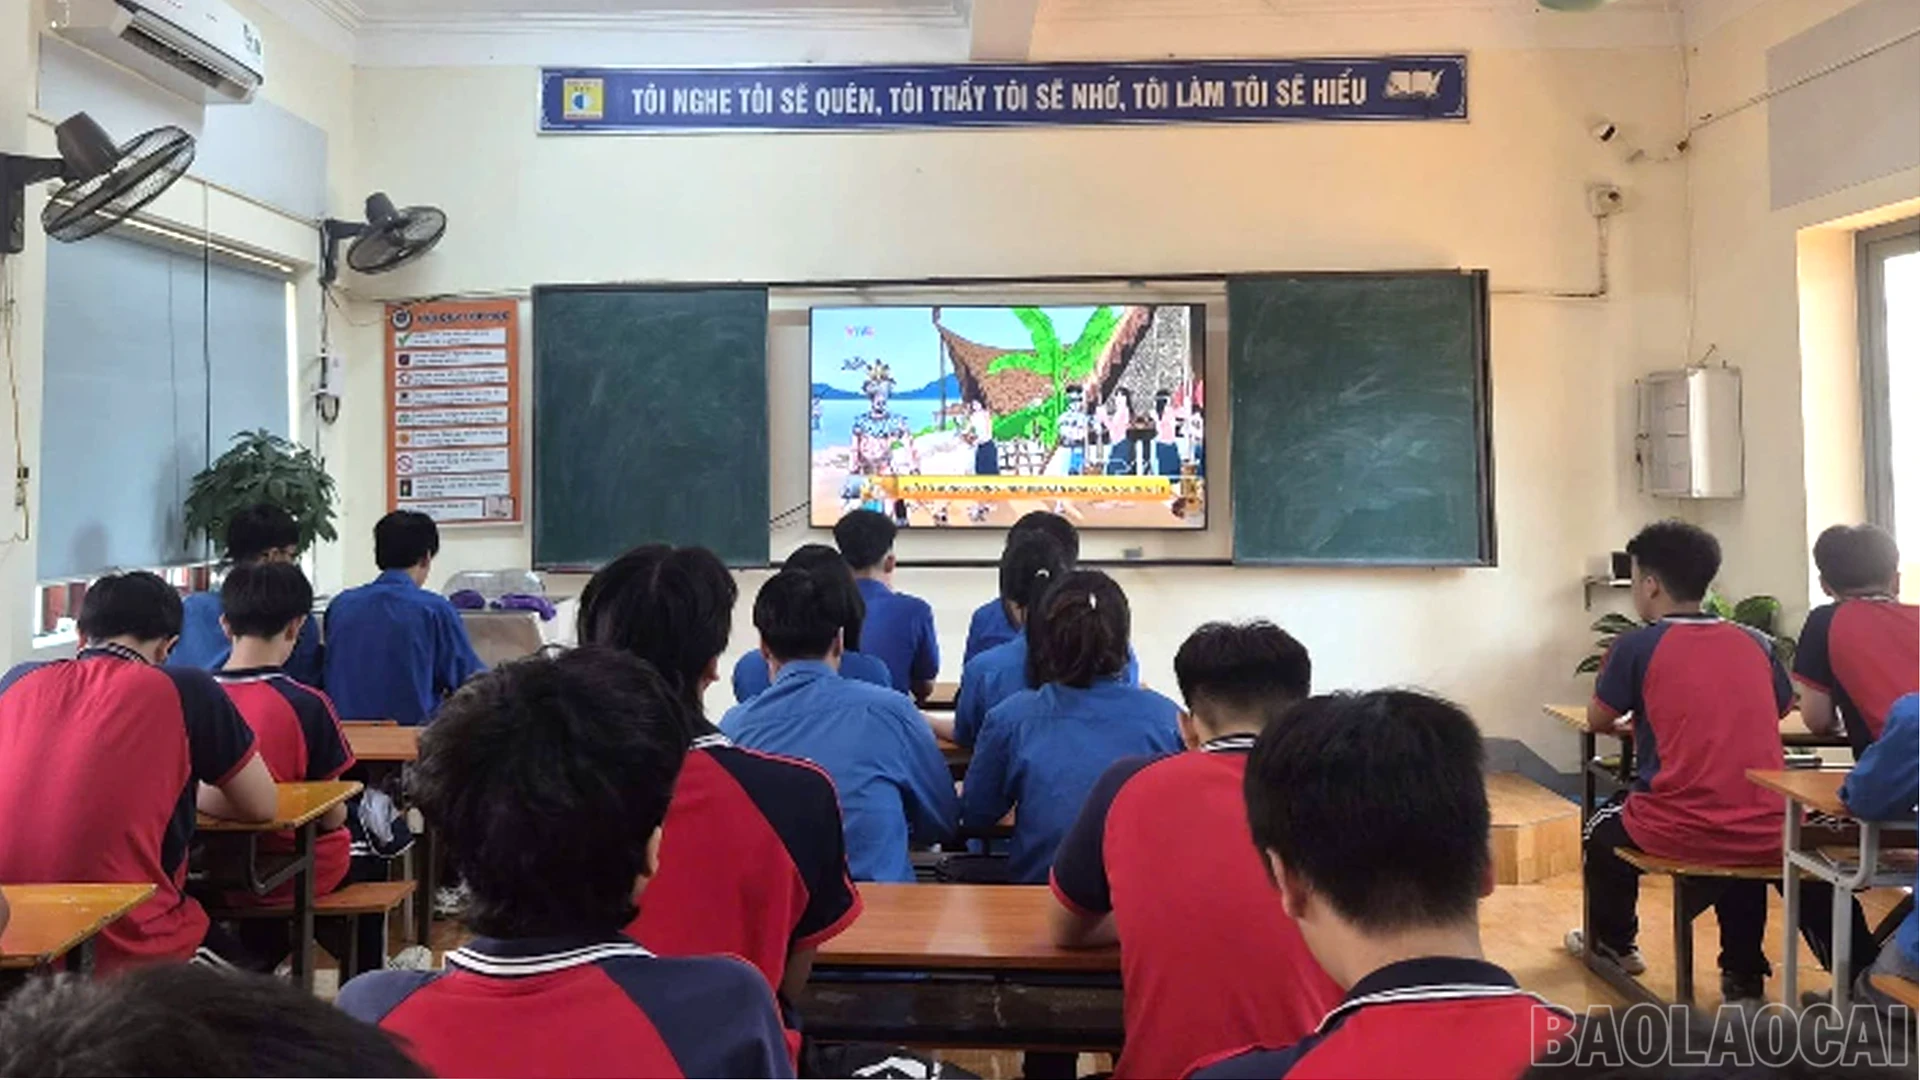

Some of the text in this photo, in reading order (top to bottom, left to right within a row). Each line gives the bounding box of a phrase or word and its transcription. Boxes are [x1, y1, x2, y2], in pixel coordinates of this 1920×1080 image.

[631, 83, 666, 115] TÔI
[673, 88, 732, 115] NGHE
[739, 82, 773, 114] TÔI
[780, 83, 808, 114] SẼ
[815, 82, 882, 116] QUÊN,
[889, 82, 923, 114] TÔI
[930, 75, 986, 112] THẤY
[993, 79, 1028, 112] TÔI
[1036, 78, 1065, 110] SẼ
[1071, 75, 1126, 112] NHỚ,
[1132, 76, 1168, 110] TÔI
[1176, 75, 1224, 108] LÀM
[1232, 74, 1268, 107] TÔI
[1276, 73, 1305, 105] SẼ
